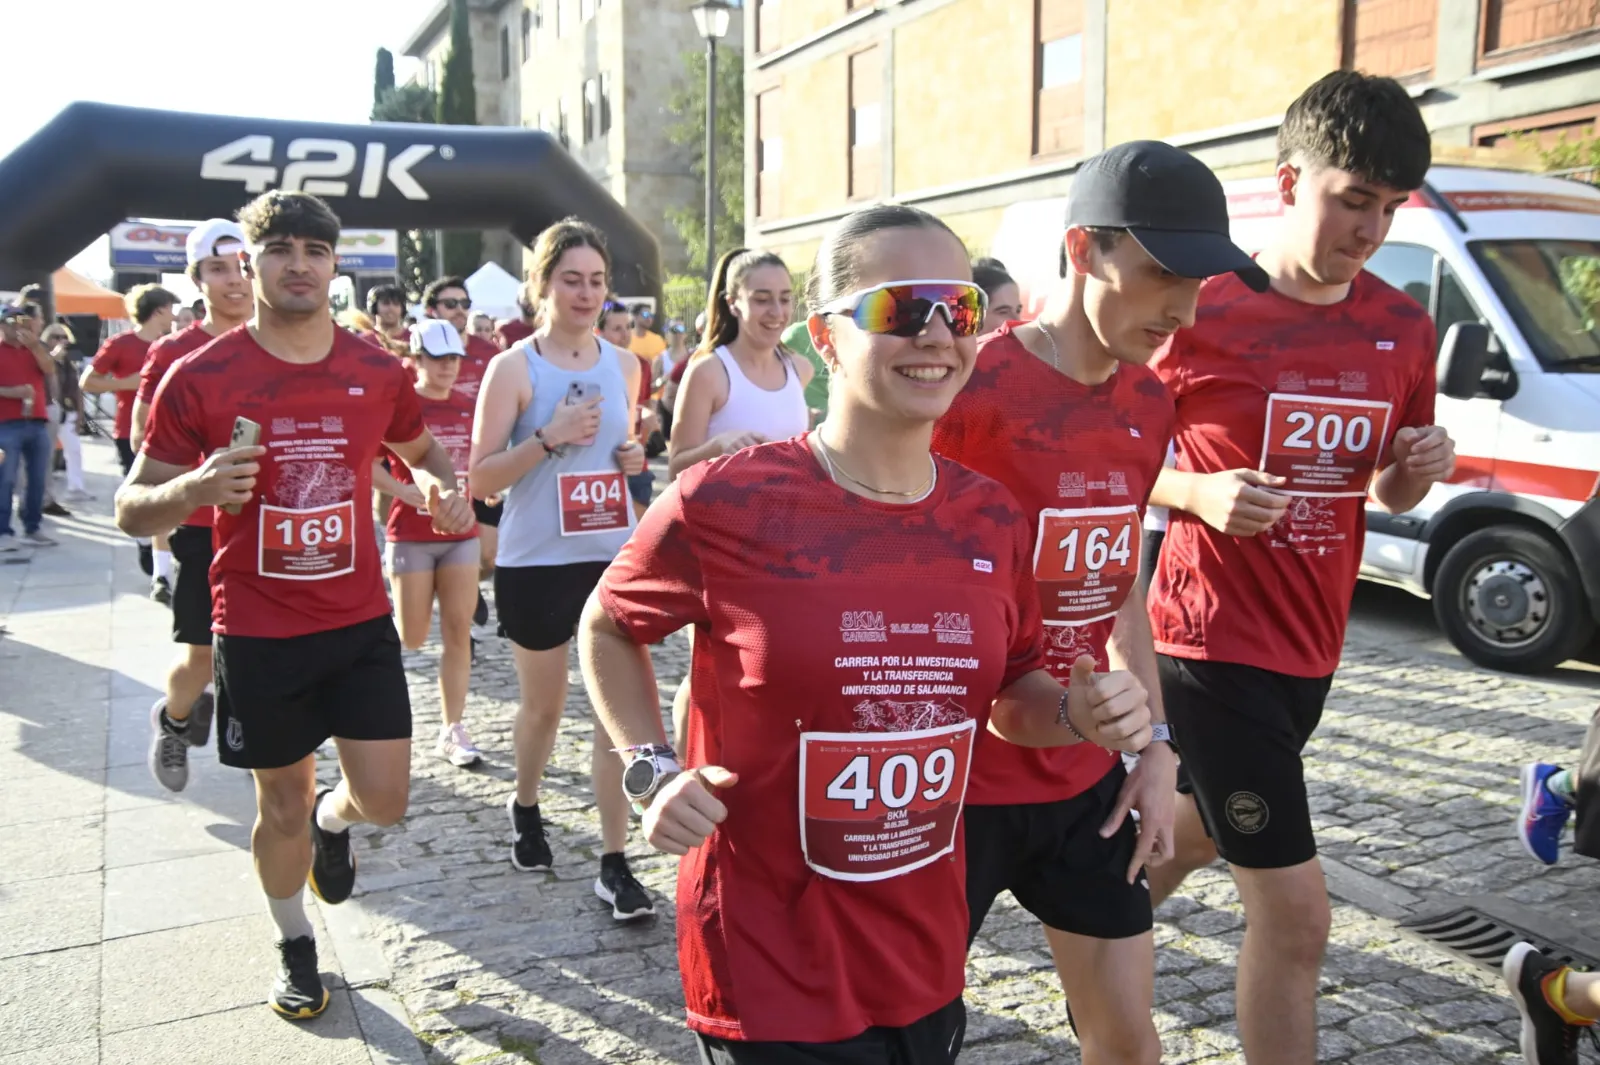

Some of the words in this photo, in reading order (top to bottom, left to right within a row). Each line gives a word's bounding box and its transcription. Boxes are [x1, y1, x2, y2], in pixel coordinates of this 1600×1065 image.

[201, 134, 435, 200] 42K
[1282, 411, 1371, 452] 200
[570, 479, 621, 504] 404
[275, 515, 343, 546] 169
[1058, 524, 1131, 572] 164
[842, 611, 885, 628] 8KM
[934, 612, 971, 630] 2KM
[842, 631, 888, 643] CARRERA
[835, 656, 879, 668] CARRERA
[882, 656, 900, 667] POR
[902, 656, 914, 667] LA
[915, 656, 979, 669] INVESTIGACIÓN
[863, 671, 869, 681] Y
[871, 671, 882, 680] LA
[884, 671, 953, 681] TRANSFERENCIA
[842, 685, 901, 695] UNIVERSIDAD
[903, 685, 915, 695] DE
[917, 685, 967, 695] SALAMANCA
[826, 747, 956, 810] 409
[887, 809, 908, 820] 8KM
[844, 834, 876, 842] CARRERA
[876, 833, 889, 841] POR
[863, 844, 869, 852] Y
[869, 843, 878, 851] LA
[879, 835, 921, 850] TRANSFERENCIA
[848, 852, 890, 862] UNIVERSIDAD
[891, 850, 899, 858] DE
[900, 841, 930, 856] SALAMANCA
